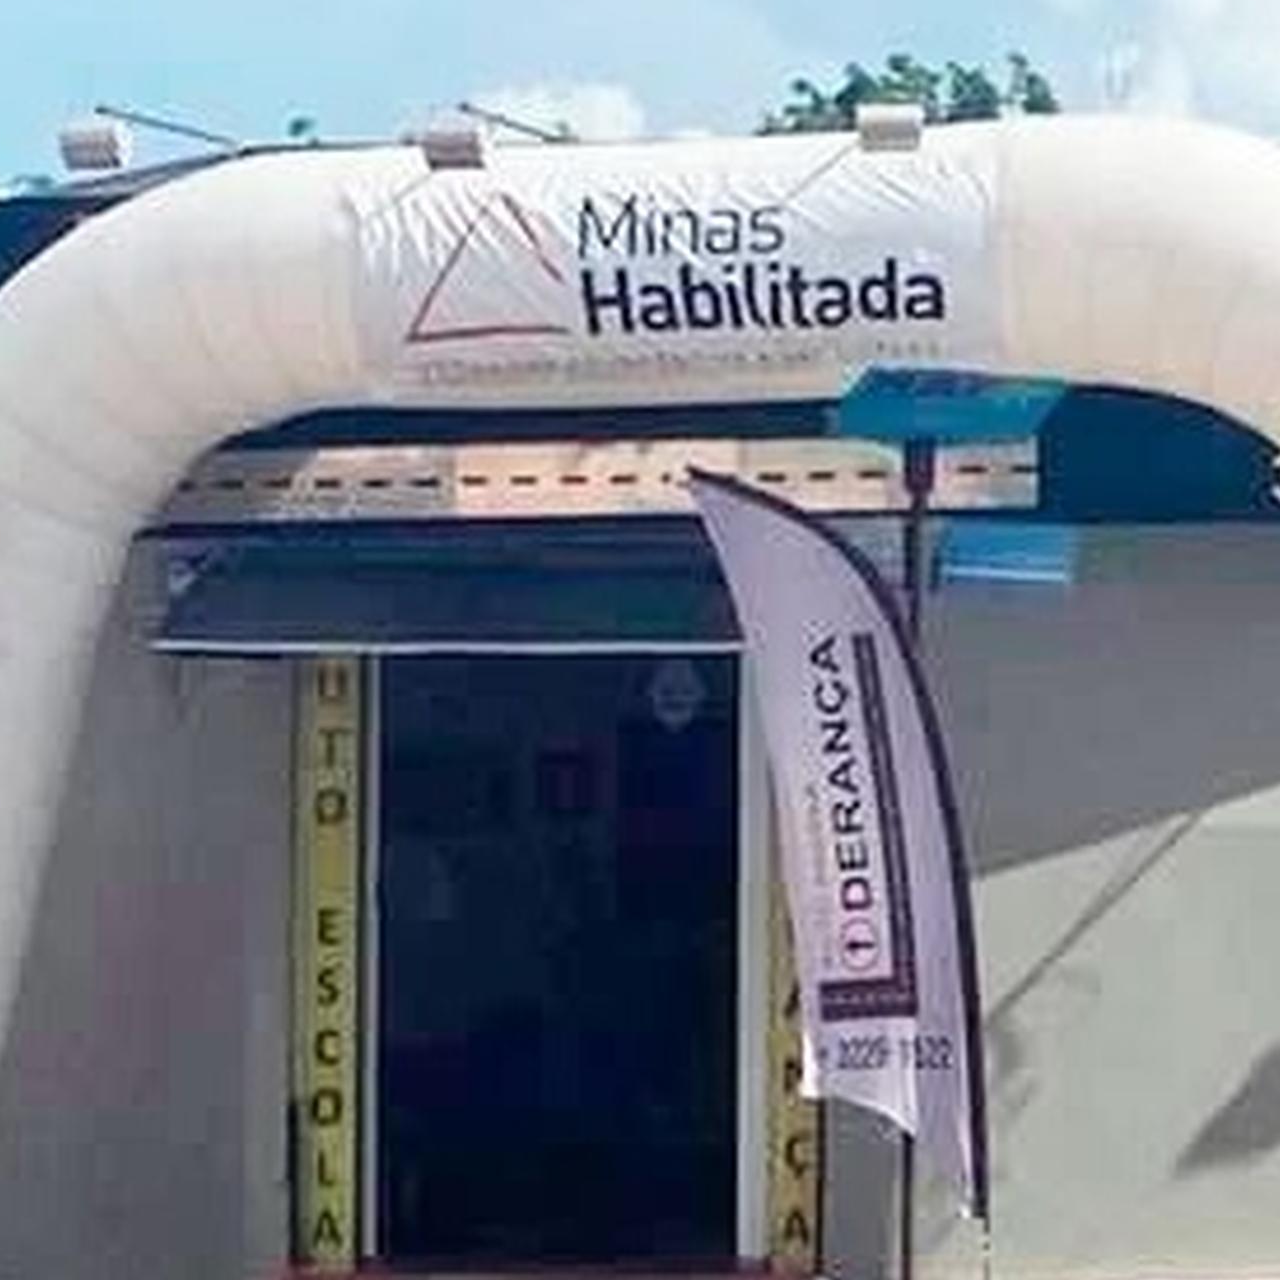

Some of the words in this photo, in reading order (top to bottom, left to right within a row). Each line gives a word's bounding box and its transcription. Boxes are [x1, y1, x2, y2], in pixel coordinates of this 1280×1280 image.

[578, 195, 784, 259] Minas
[580, 258, 946, 335] Habilitada
[310, 906, 345, 1251] ESCOLA
